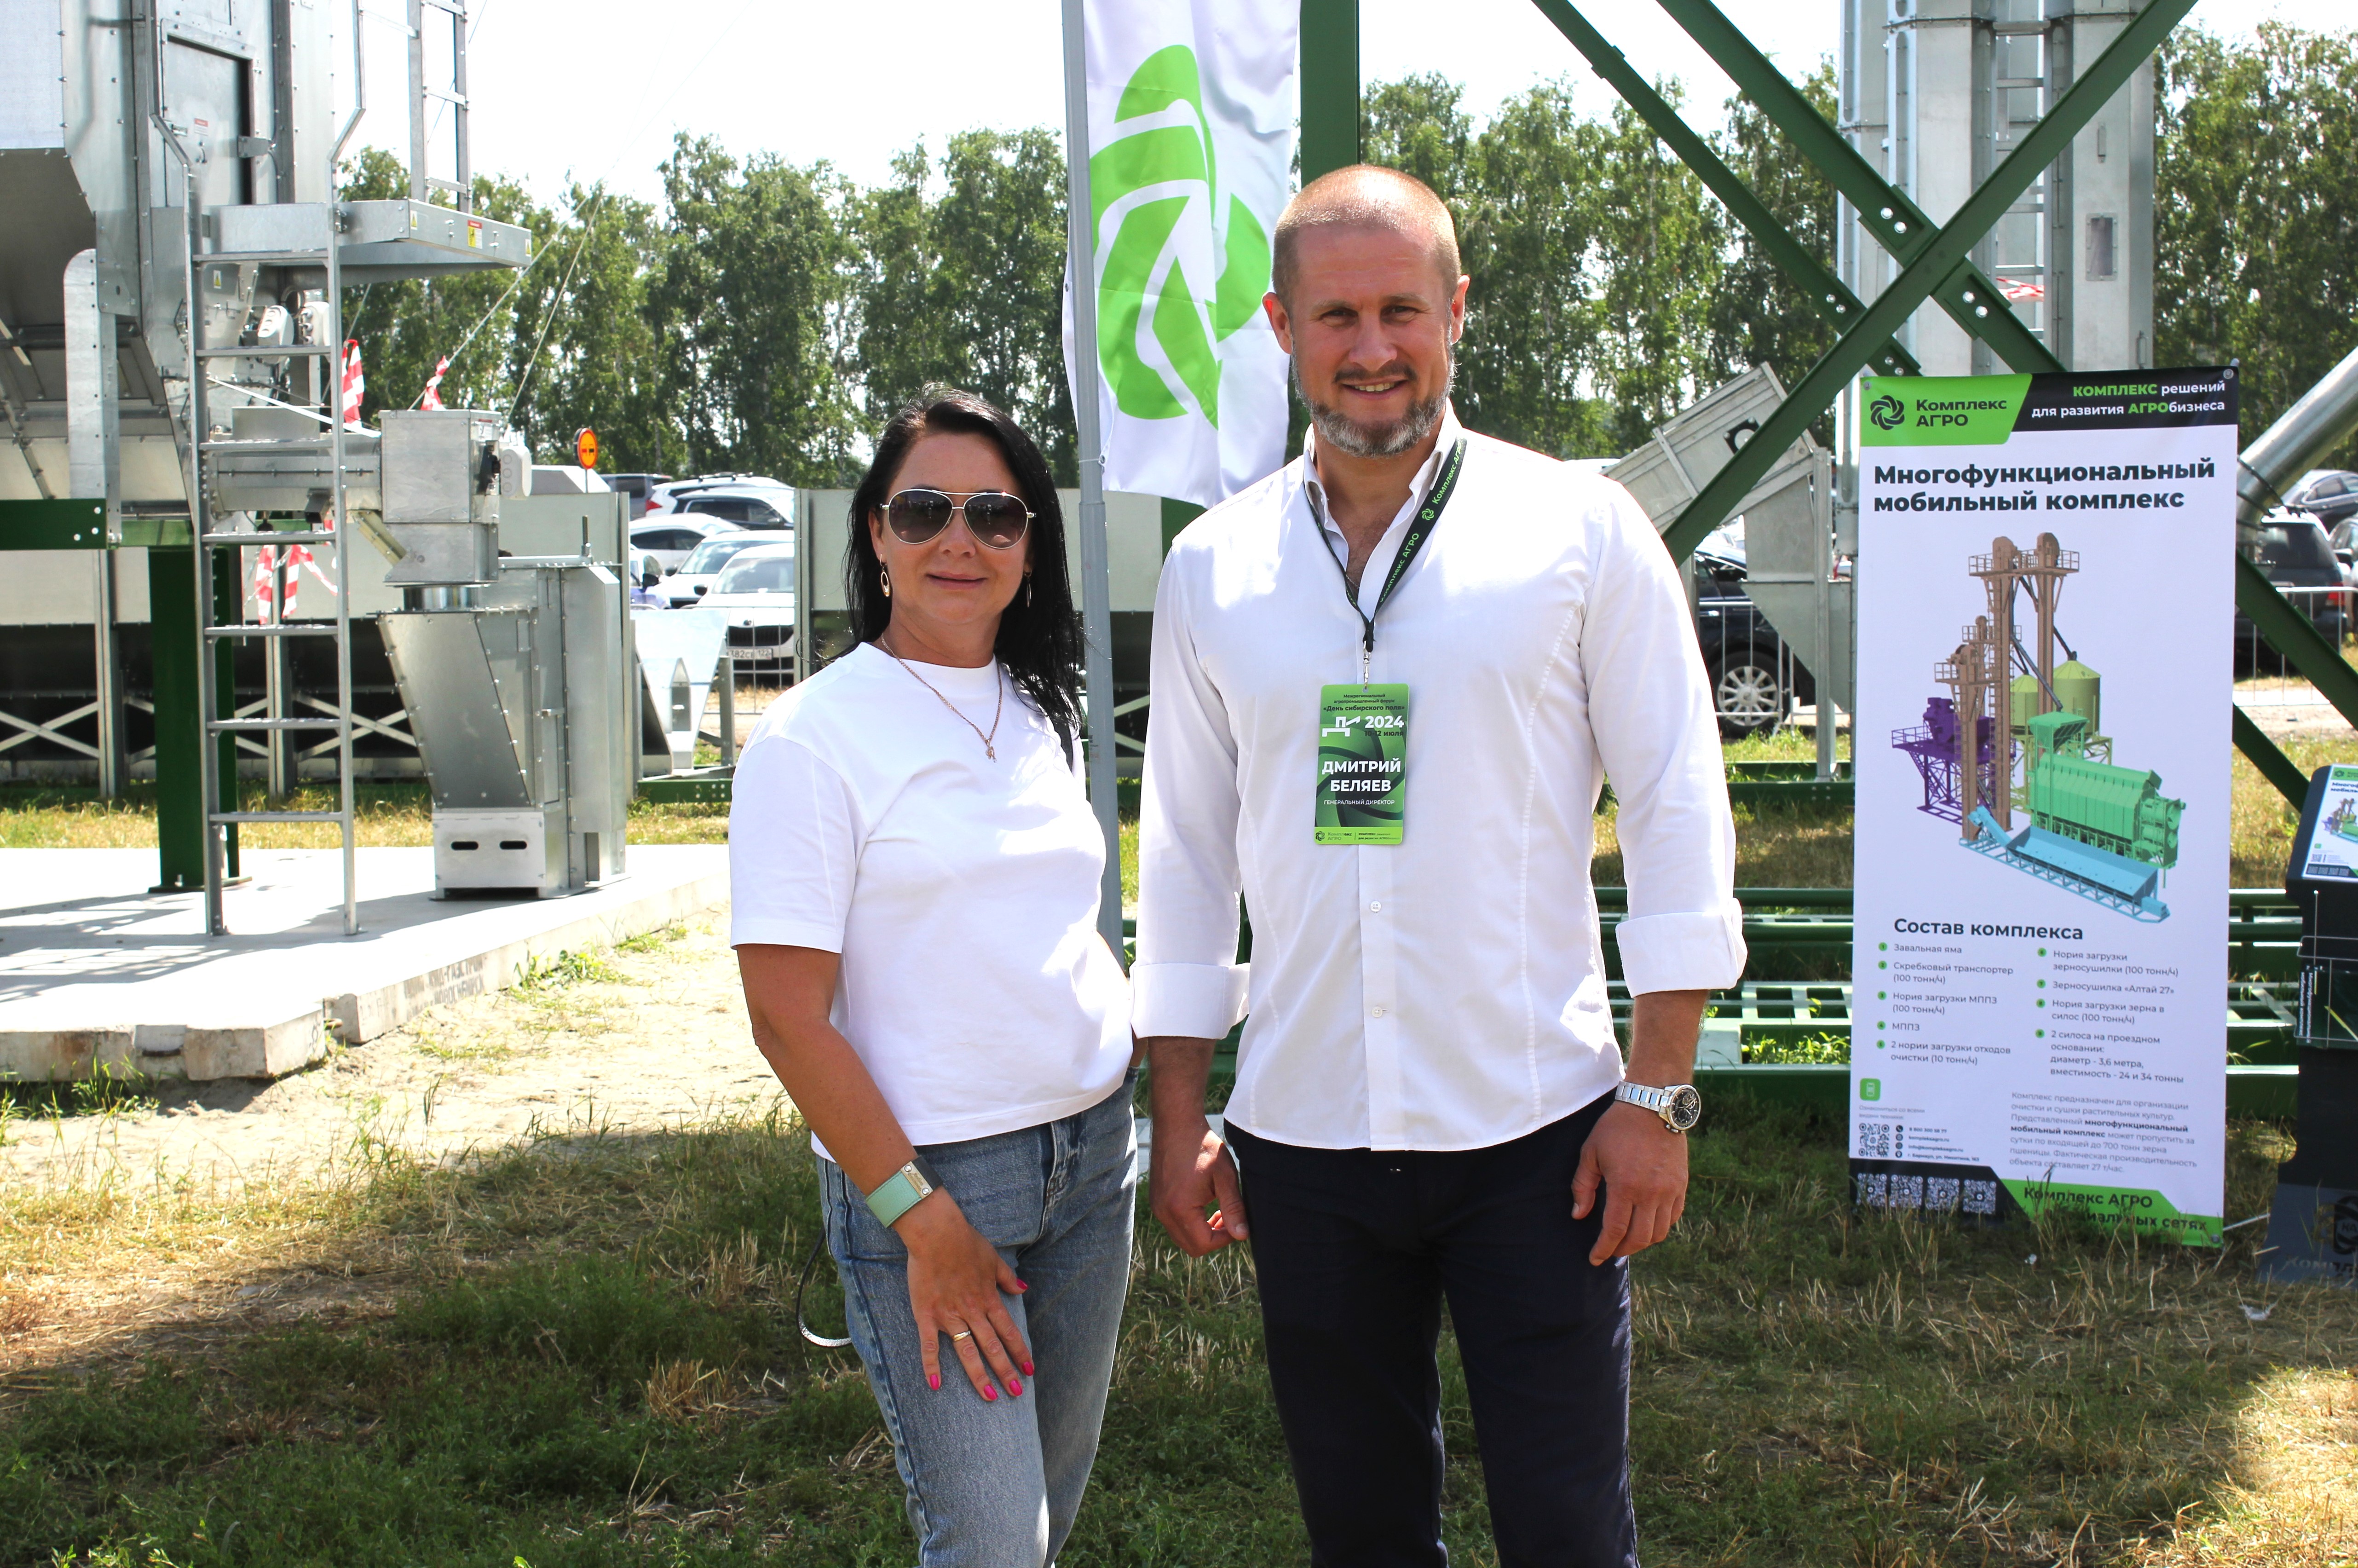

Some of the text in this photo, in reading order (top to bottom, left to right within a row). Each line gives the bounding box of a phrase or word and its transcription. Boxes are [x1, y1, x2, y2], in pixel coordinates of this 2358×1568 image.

[2073, 380, 2225, 397] КОМПЛЕКС решений
[1916, 399, 2007, 414] Комплекс
[2032, 399, 2225, 418] для развития АГРОбизнеса
[1916, 414, 1968, 427] АГРО
[1874, 457, 2215, 488] Многофункциональный
[1432, 464, 1456, 504] Комплекс
[1874, 489, 2184, 512] мобильный комплекс
[1403, 533, 1419, 557] АГРО
[1365, 715, 1404, 728] 2024
[1322, 758, 1401, 775] ДМИТРИЙ
[1330, 780, 1391, 792] БЕЛЯЕВ
[1894, 918, 2083, 940] Состав комплекса
[1894, 944, 1942, 952] Завальная
[2053, 950, 2083, 959] Нория
[2086, 952, 2127, 962] загрузки
[1894, 962, 1951, 971] Скребковый
[1954, 966, 2014, 976] транспортер
[2053, 963, 2179, 977] зерносушилки (100 тонн/ч)
[1893, 974, 1946, 984] (100 тонн/ч)
[2052, 981, 2122, 992] Зерносушилка
[2124, 984, 2157, 993] «Алтай
[1893, 992, 1922, 1001] Нория
[1925, 995, 1966, 1003] загрузки
[1969, 996, 1997, 1004] МППЗ
[1892, 1004, 1945, 1015] (100 тонн/ч)
[2052, 999, 2082, 1009] Нория
[2085, 1002, 2126, 1012] загрузки
[2128, 1005, 2156, 1013] зерна
[2082, 1013, 2099, 1022] (100
[2102, 1014, 2135, 1025] тонн/ч)
[1892, 1022, 1920, 1031] МППЗ
[2108, 1035, 2160, 1044] проездном
[1898, 1042, 1928, 1050] нории
[1931, 1043, 1972, 1052] загрузки
[1974, 1046, 2011, 1054] отходов
[2051, 1043, 2104, 1053] основании:
[1931, 1055, 1943, 1064] (10
[1946, 1056, 1978, 1066] тонн/ч)
[2050, 1056, 2091, 1065] диаметр
[2099, 1058, 2111, 1066] 3,6
[2114, 1060, 2144, 1069] метра,
[2050, 1068, 2111, 1078] вместимость
[2141, 1073, 2152, 1081] 34
[2154, 1075, 2184, 1083] тонны
[2012, 1092, 2052, 1101] Комплекс
[2054, 1095, 2114, 1105] предназначен
[2133, 1100, 2189, 1110] организации
[2082, 1108, 2140, 1118] растительных
[2142, 1113, 2175, 1121] культур.
[2011, 1113, 2189, 1133] Представленный многофункциональный
[2011, 1125, 2061, 1135] мобильный
[2064, 1129, 2105, 1138] комплекс
[2136, 1134, 2184, 1144] пропустить
[2047, 1139, 2089, 1148] входящей
[2103, 1141, 2119, 1150] 700
[2142, 1146, 2167, 1154] зерна
[2009, 1158, 2042, 1166] объекта
[2044, 1162, 2089, 1170] составляет
[2053, 1150, 2107, 1160] Фактическая
[2110, 1154, 2197, 1168] производительность
[2024, 1187, 2153, 1208] Комплекс АГРО
